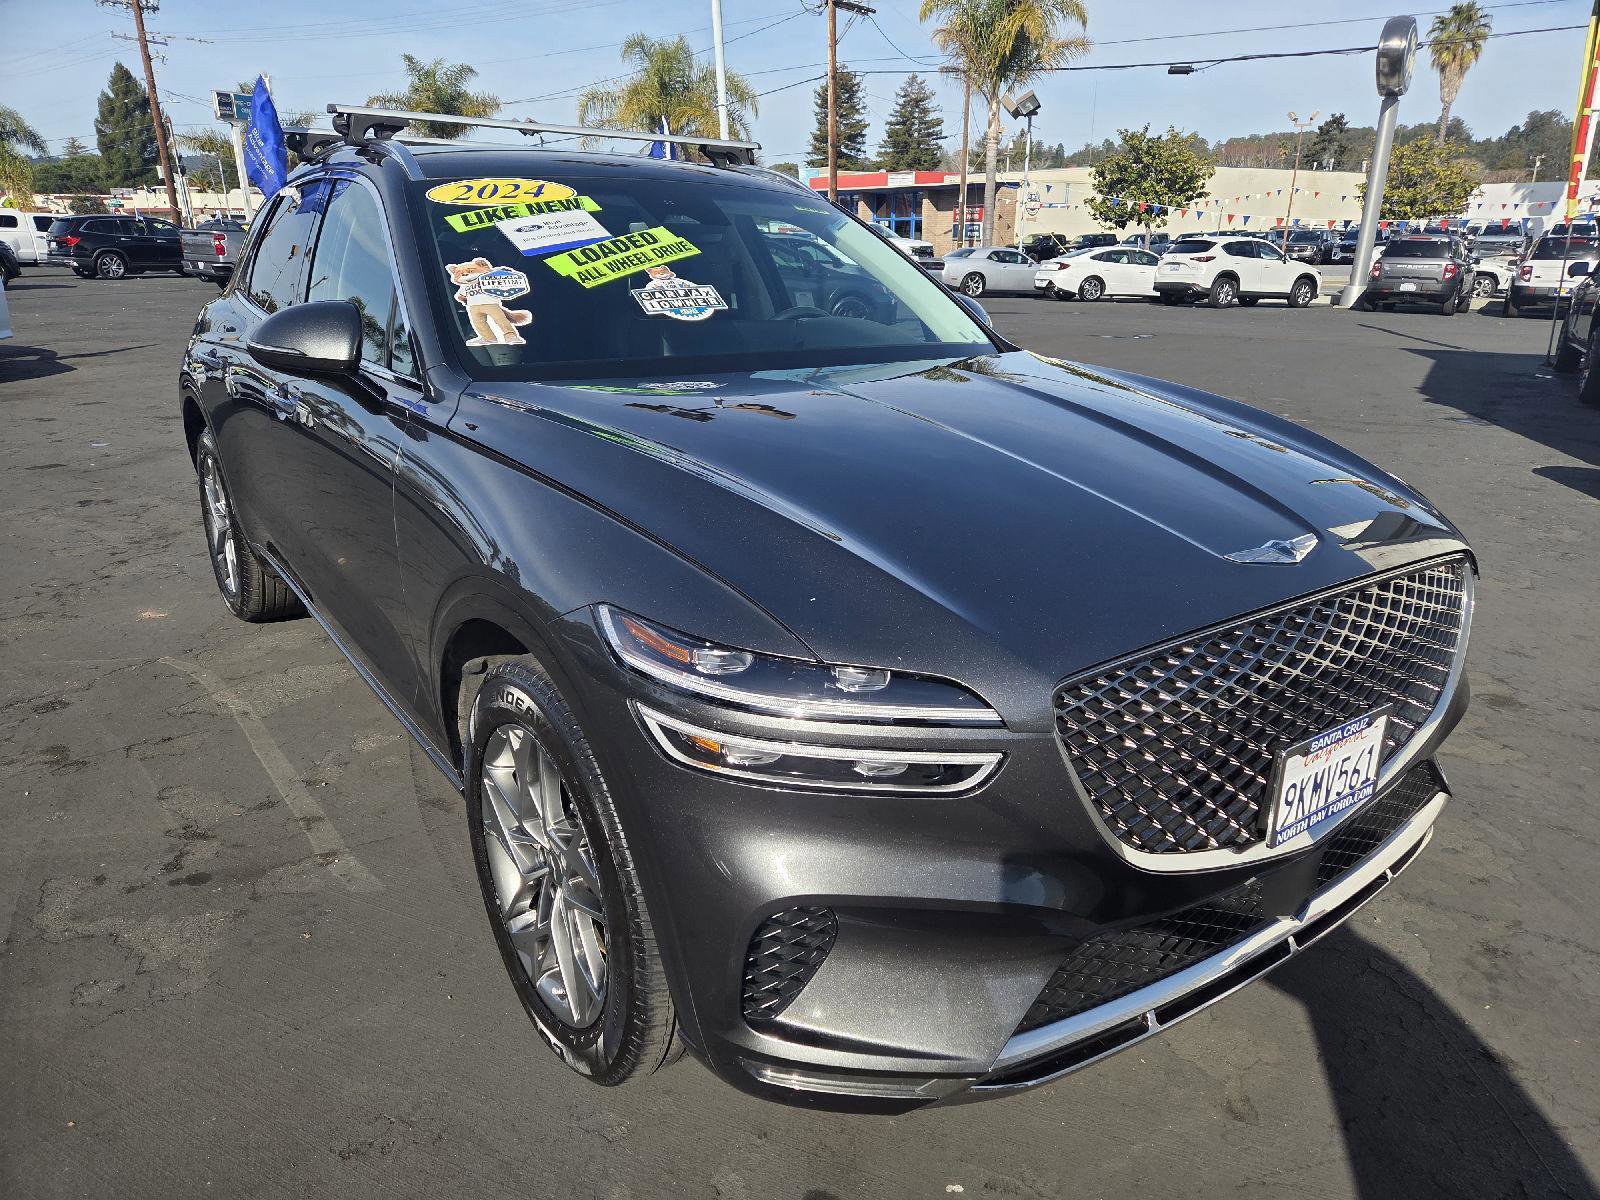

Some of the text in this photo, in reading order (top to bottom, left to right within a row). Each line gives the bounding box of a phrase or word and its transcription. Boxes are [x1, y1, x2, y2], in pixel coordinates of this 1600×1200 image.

[248, 134, 275, 175] Advantage
[454, 182, 546, 201] 2024
[461, 197, 583, 227] LIKE NEW
[568, 231, 661, 267] LOADED
[577, 239, 693, 284] ALL WHEEL DRIVE
[640, 288, 714, 300] CARFAX
[659, 298, 722, 309] OWNER
[1310, 717, 1370, 751] SANTA CRUZ
[1281, 744, 1376, 829] 9KMV561
[1276, 784, 1374, 845] NORTH BAY FORD.COM
